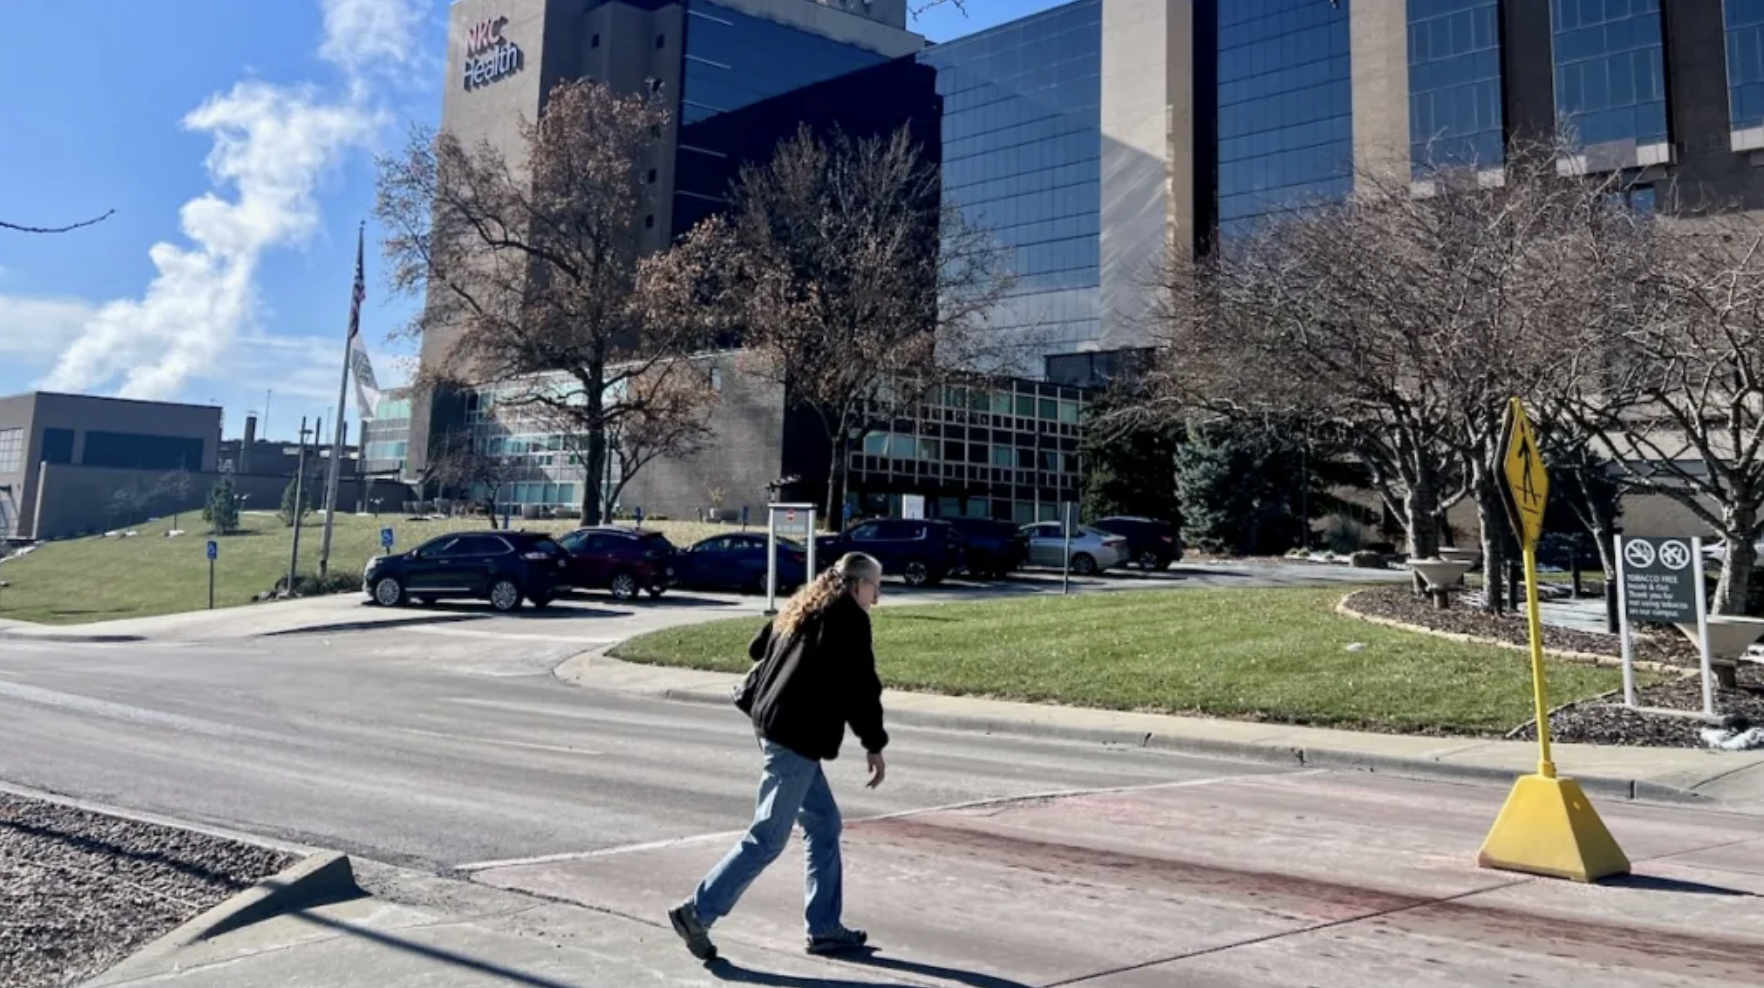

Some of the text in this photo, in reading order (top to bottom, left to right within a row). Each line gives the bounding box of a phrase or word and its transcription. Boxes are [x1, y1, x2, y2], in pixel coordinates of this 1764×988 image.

[467, 16, 507, 55] NKC
[464, 42, 521, 90] Health
[1627, 574, 1678, 584] TOBACCO FREE
[1628, 590, 1647, 598] Thank
[1661, 600, 1688, 609] tobacco
